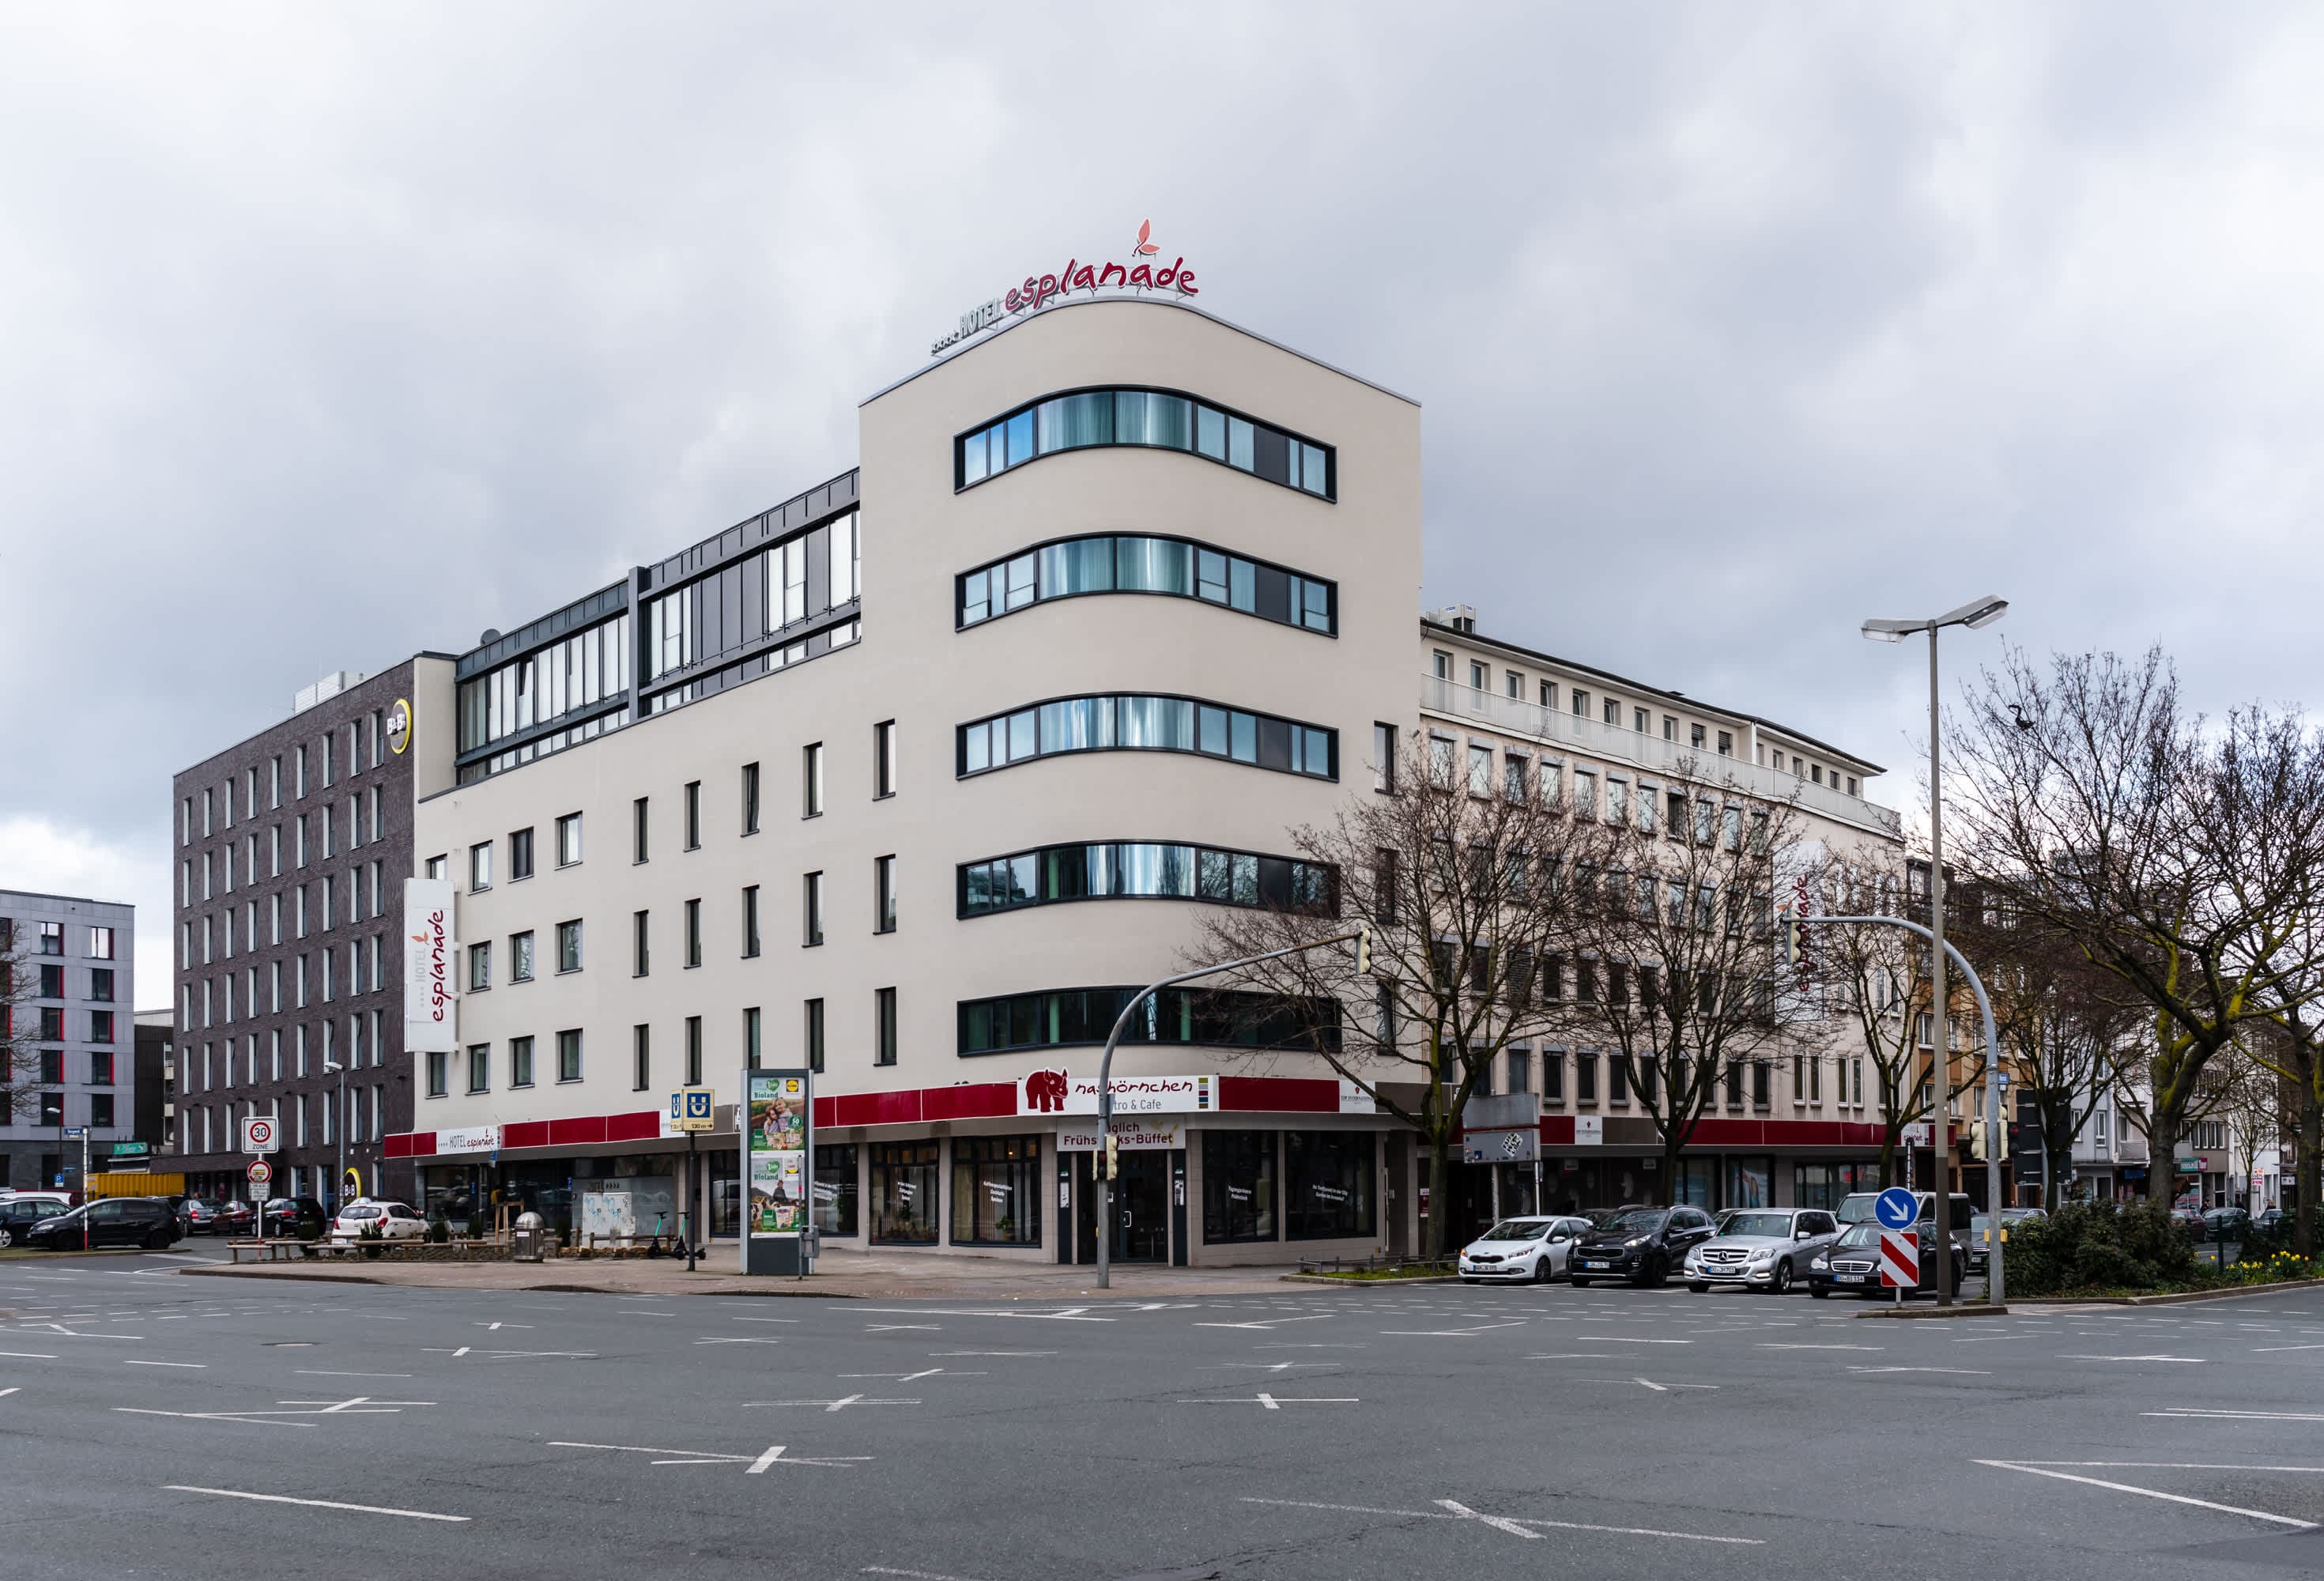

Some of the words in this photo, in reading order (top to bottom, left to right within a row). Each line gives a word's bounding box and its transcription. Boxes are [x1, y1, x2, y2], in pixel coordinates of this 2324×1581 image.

[960, 296, 1000, 338] HOTEL
[1005, 256, 1199, 310] esplanade
[415, 948, 427, 983] HOTEL
[428, 910, 452, 1021] esplanade
[1130, 1100, 1137, 1111] &
[1140, 1099, 1162, 1110] Cafe
[254, 1127, 267, 1138] 30
[1064, 1133, 1173, 1146] Frühsks-Büffet
[450, 1134, 466, 1149] HOTEL
[467, 1135, 495, 1151] esplanade
